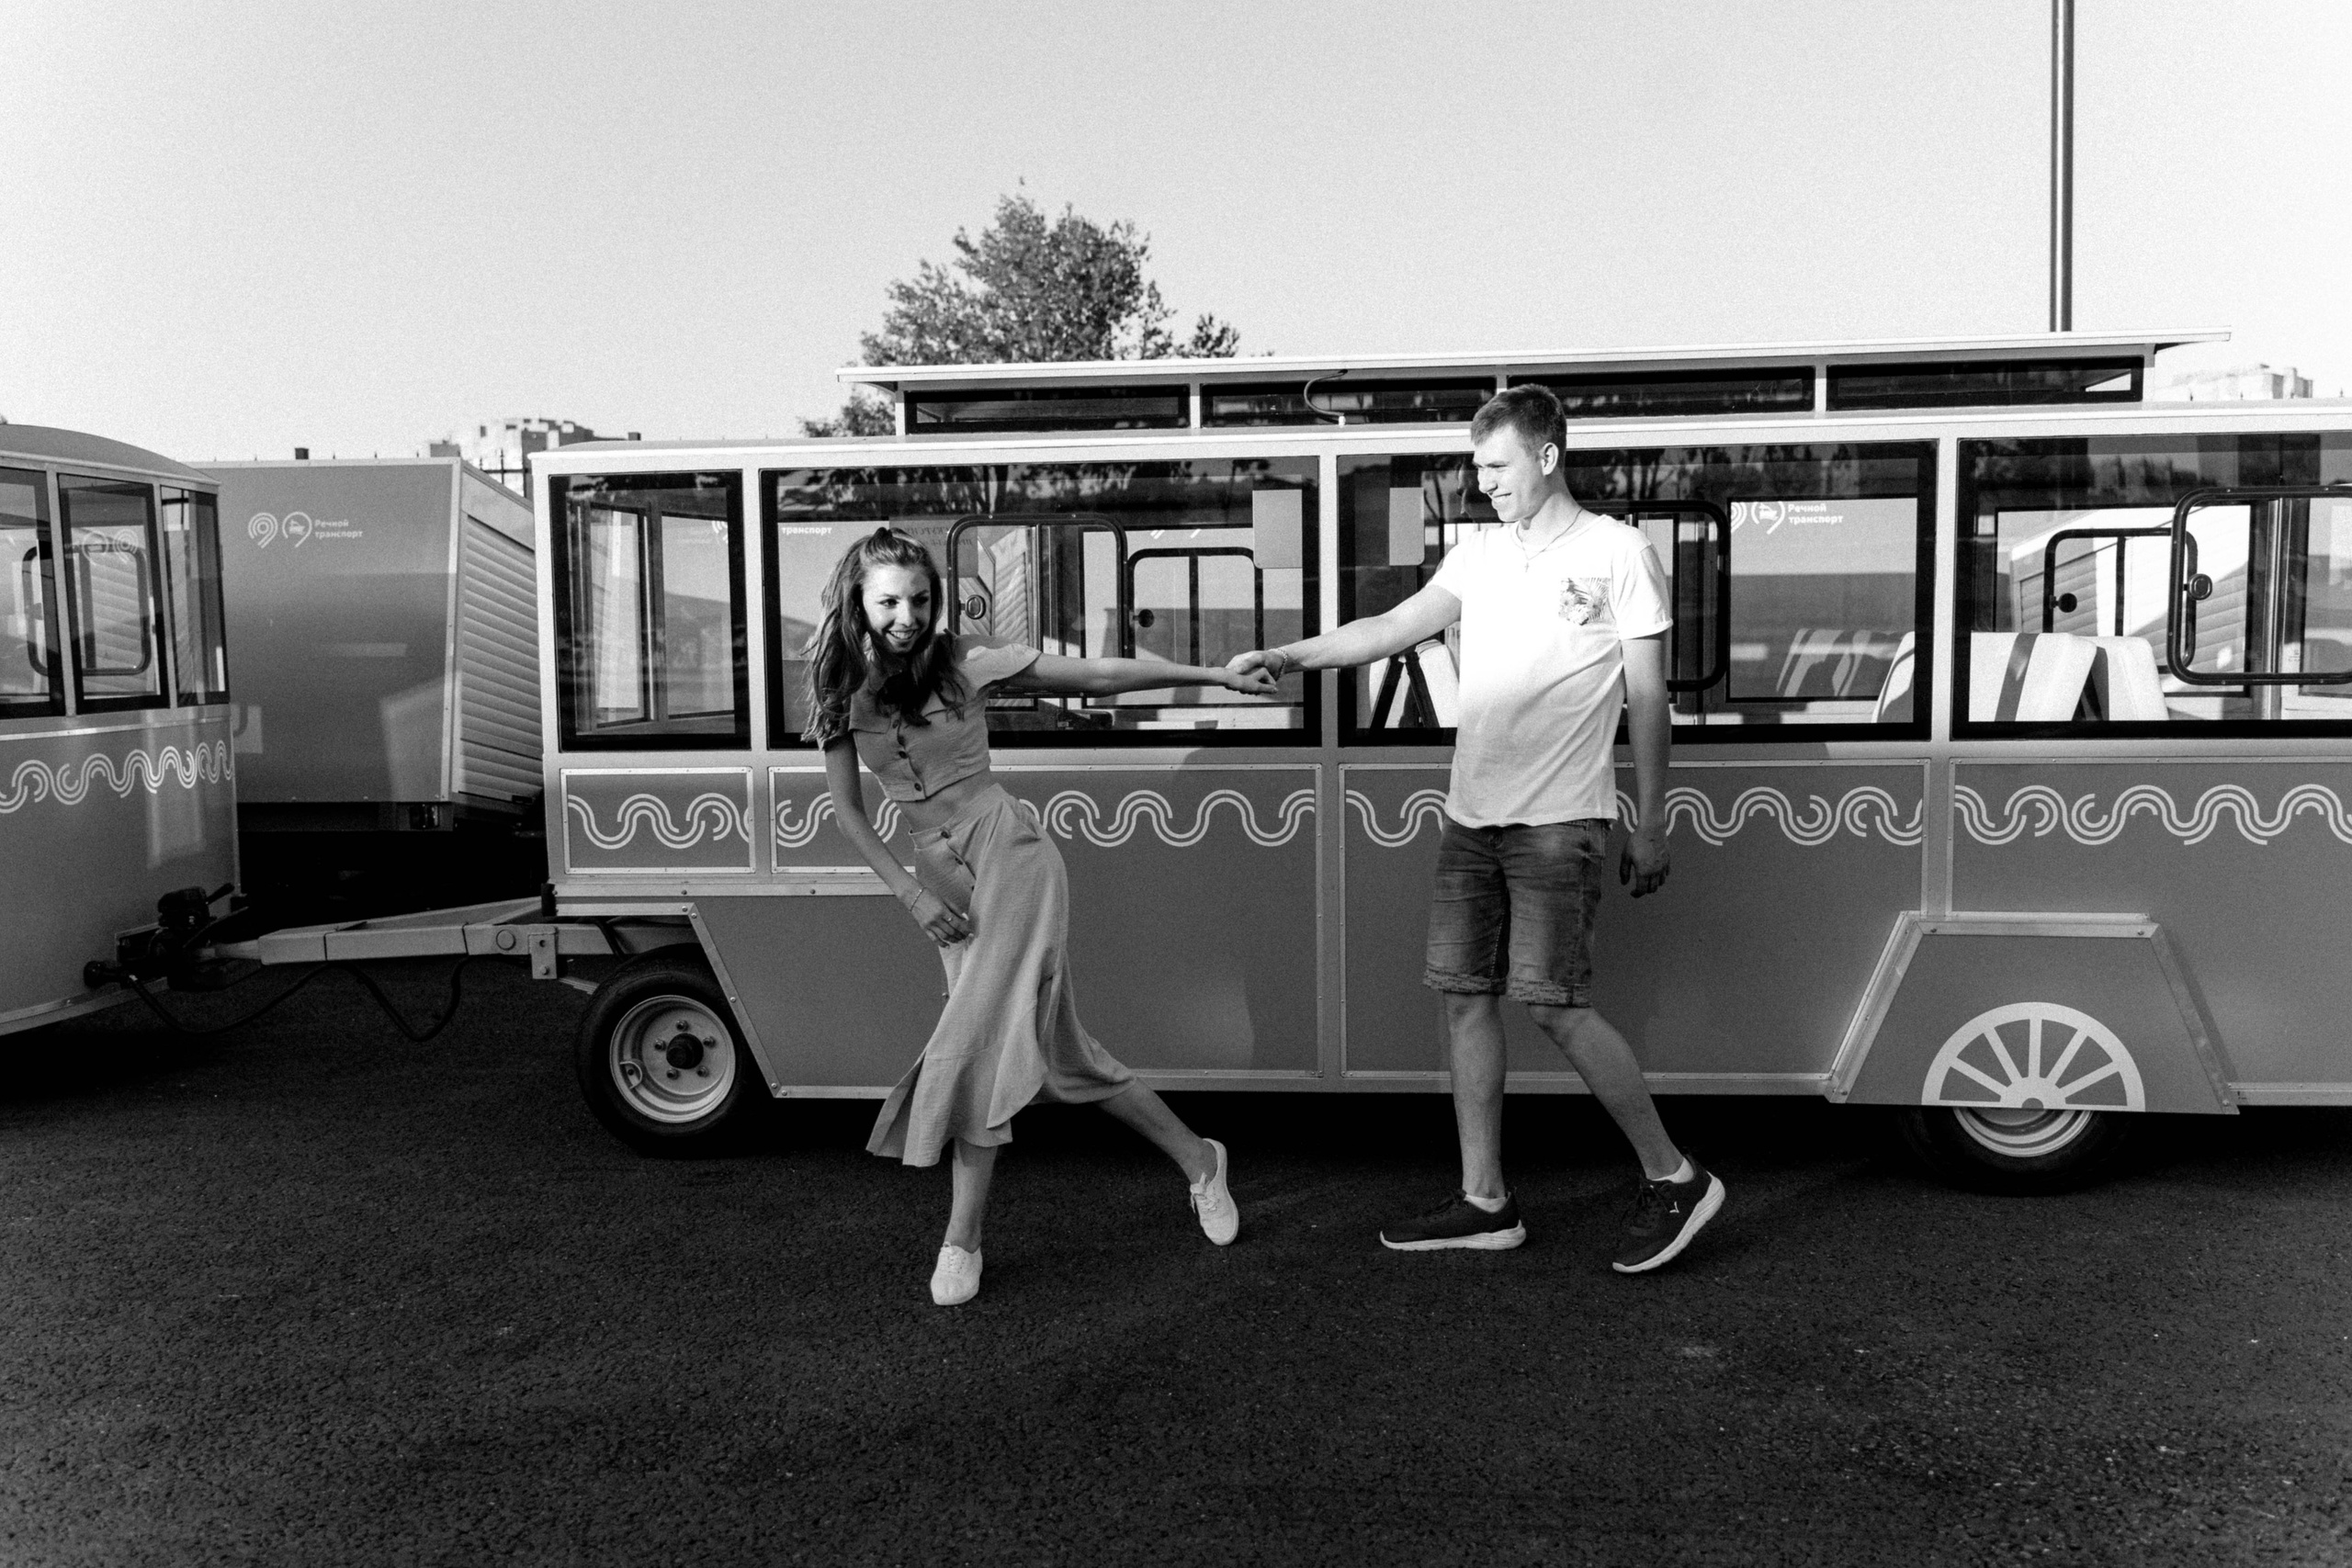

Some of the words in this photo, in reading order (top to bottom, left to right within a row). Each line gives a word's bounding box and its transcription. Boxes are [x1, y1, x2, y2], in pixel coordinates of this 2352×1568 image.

[1788, 502, 1827, 513] Речной
[314, 519, 349, 528] Речной
[1788, 515, 1844, 526] транспорт
[314, 530, 364, 540] транспорт
[781, 526, 832, 536] транспорт
